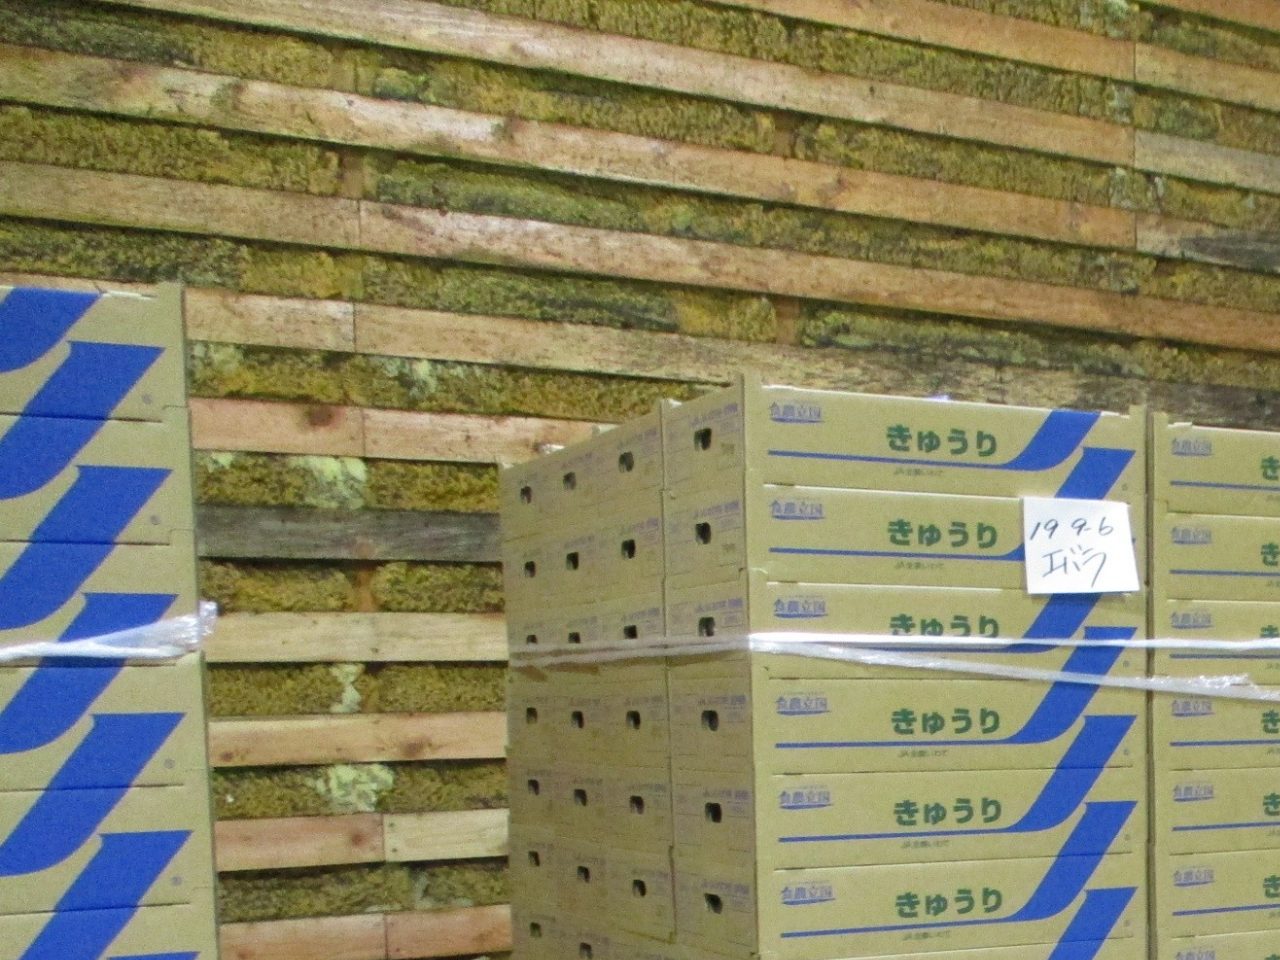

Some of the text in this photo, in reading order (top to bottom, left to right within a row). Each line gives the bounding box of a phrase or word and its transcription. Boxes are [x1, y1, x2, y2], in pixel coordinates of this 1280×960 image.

[887, 424, 997, 457] きゅうり
[887, 518, 998, 548] きゅうり
[890, 613, 999, 635] きゅうり
[891, 707, 1000, 735] きゅうり
[895, 797, 1001, 827] きゅうり
[895, 887, 1003, 918] きゅうり
